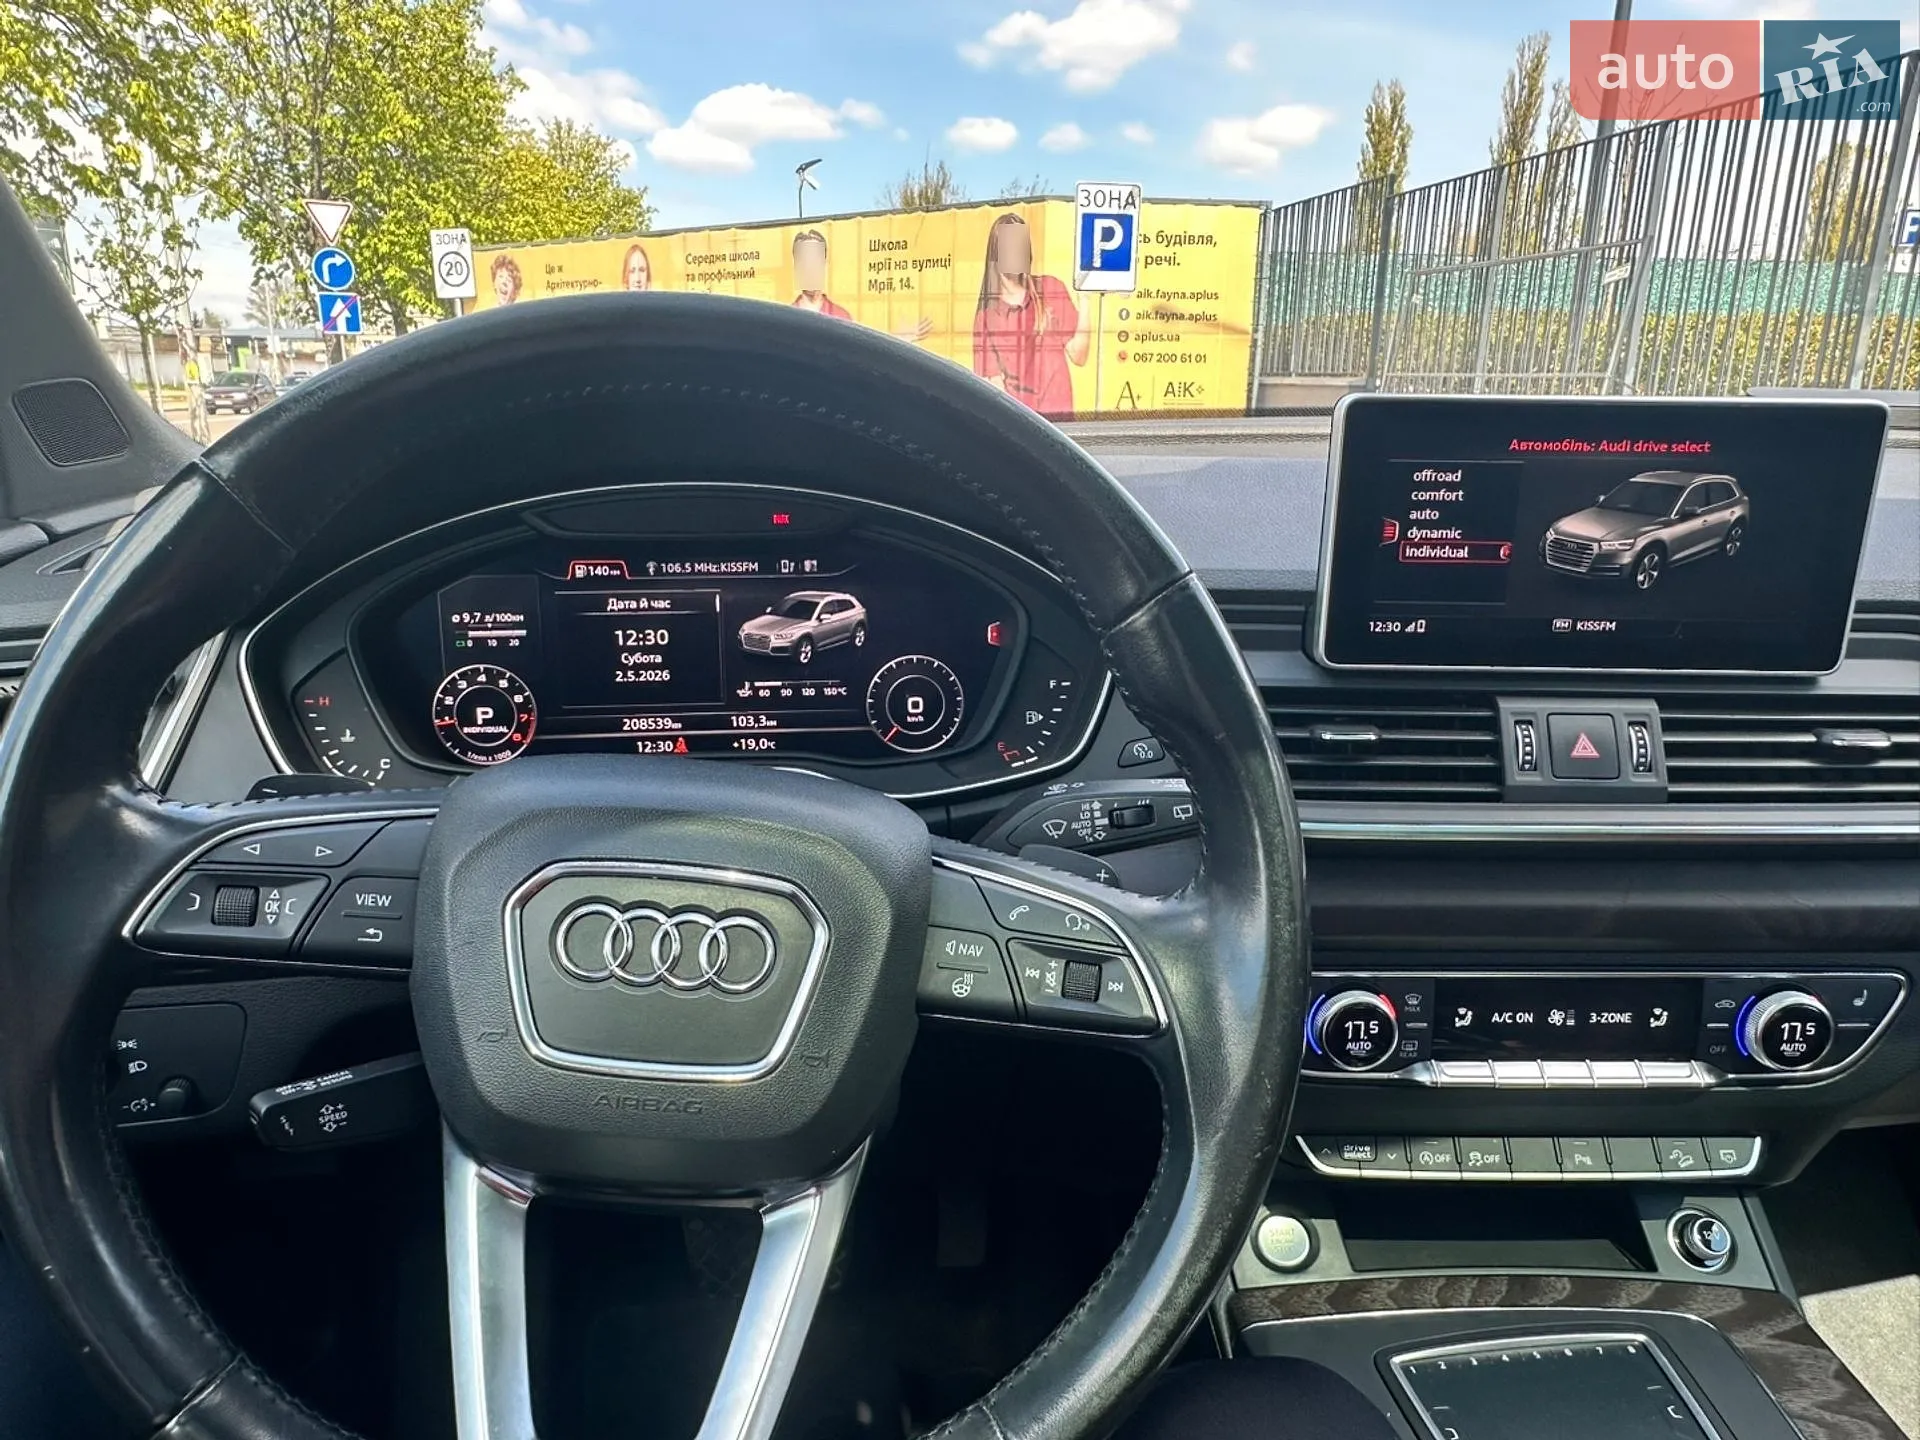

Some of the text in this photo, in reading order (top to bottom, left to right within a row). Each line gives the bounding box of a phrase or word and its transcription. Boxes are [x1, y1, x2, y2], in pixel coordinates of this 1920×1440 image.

[1080, 189, 1136, 210] ЗОНА
[436, 233, 467, 245] ЗОНА
[1093, 218, 1123, 268] P
[1156, 230, 1217, 247] будівля,
[869, 239, 908, 252] Школа
[685, 251, 760, 267] Середня школа
[894, 259, 908, 270] на
[912, 253, 951, 272] вулиці
[1144, 252, 1181, 269] речі.
[444, 261, 463, 277] 20
[686, 267, 755, 284] та профільний
[899, 277, 914, 290] 14.
[1136, 288, 1219, 302] aik.fayna.aplus
[1136, 309, 1218, 323] aik.fayna.aplus
[1134, 331, 1180, 344] aplus.ua
[1133, 352, 1207, 363] 067 200 61 01
[1509, 439, 1711, 453] Автомобіль: Audi drive select
[1413, 469, 1462, 481] offroad
[1411, 489, 1464, 501] comfort
[1409, 508, 1440, 520] auto
[1407, 526, 1462, 542] dynamic
[1405, 545, 1469, 558] individual
[661, 563, 692, 573] 106.5
[607, 599, 637, 611] Дата
[651, 600, 671, 609] час
[462, 612, 481, 624] 9,7
[1369, 621, 1401, 632] 12:30
[1576, 620, 1616, 632] KISSFM
[613, 630, 669, 646] 12:30
[621, 653, 662, 666] Субота
[615, 670, 670, 682] 2.5.2026
[476, 707, 494, 725] P
[637, 741, 673, 753] 12:30
[1071, 820, 1091, 829] AUTO
[265, 901, 280, 913] OK
[355, 894, 392, 907] VIEW
[959, 944, 984, 957] NAV
[1491, 1012, 1533, 1023] A/C ON
[1589, 1012, 1632, 1023] 3-ZONE
[1346, 1042, 1372, 1050] AUTO
[1780, 1043, 1807, 1052] AUTO
[593, 1094, 703, 1113] AIRBAG
[1435, 1154, 1450, 1163] OFF
[1484, 1155, 1500, 1163] OFF
